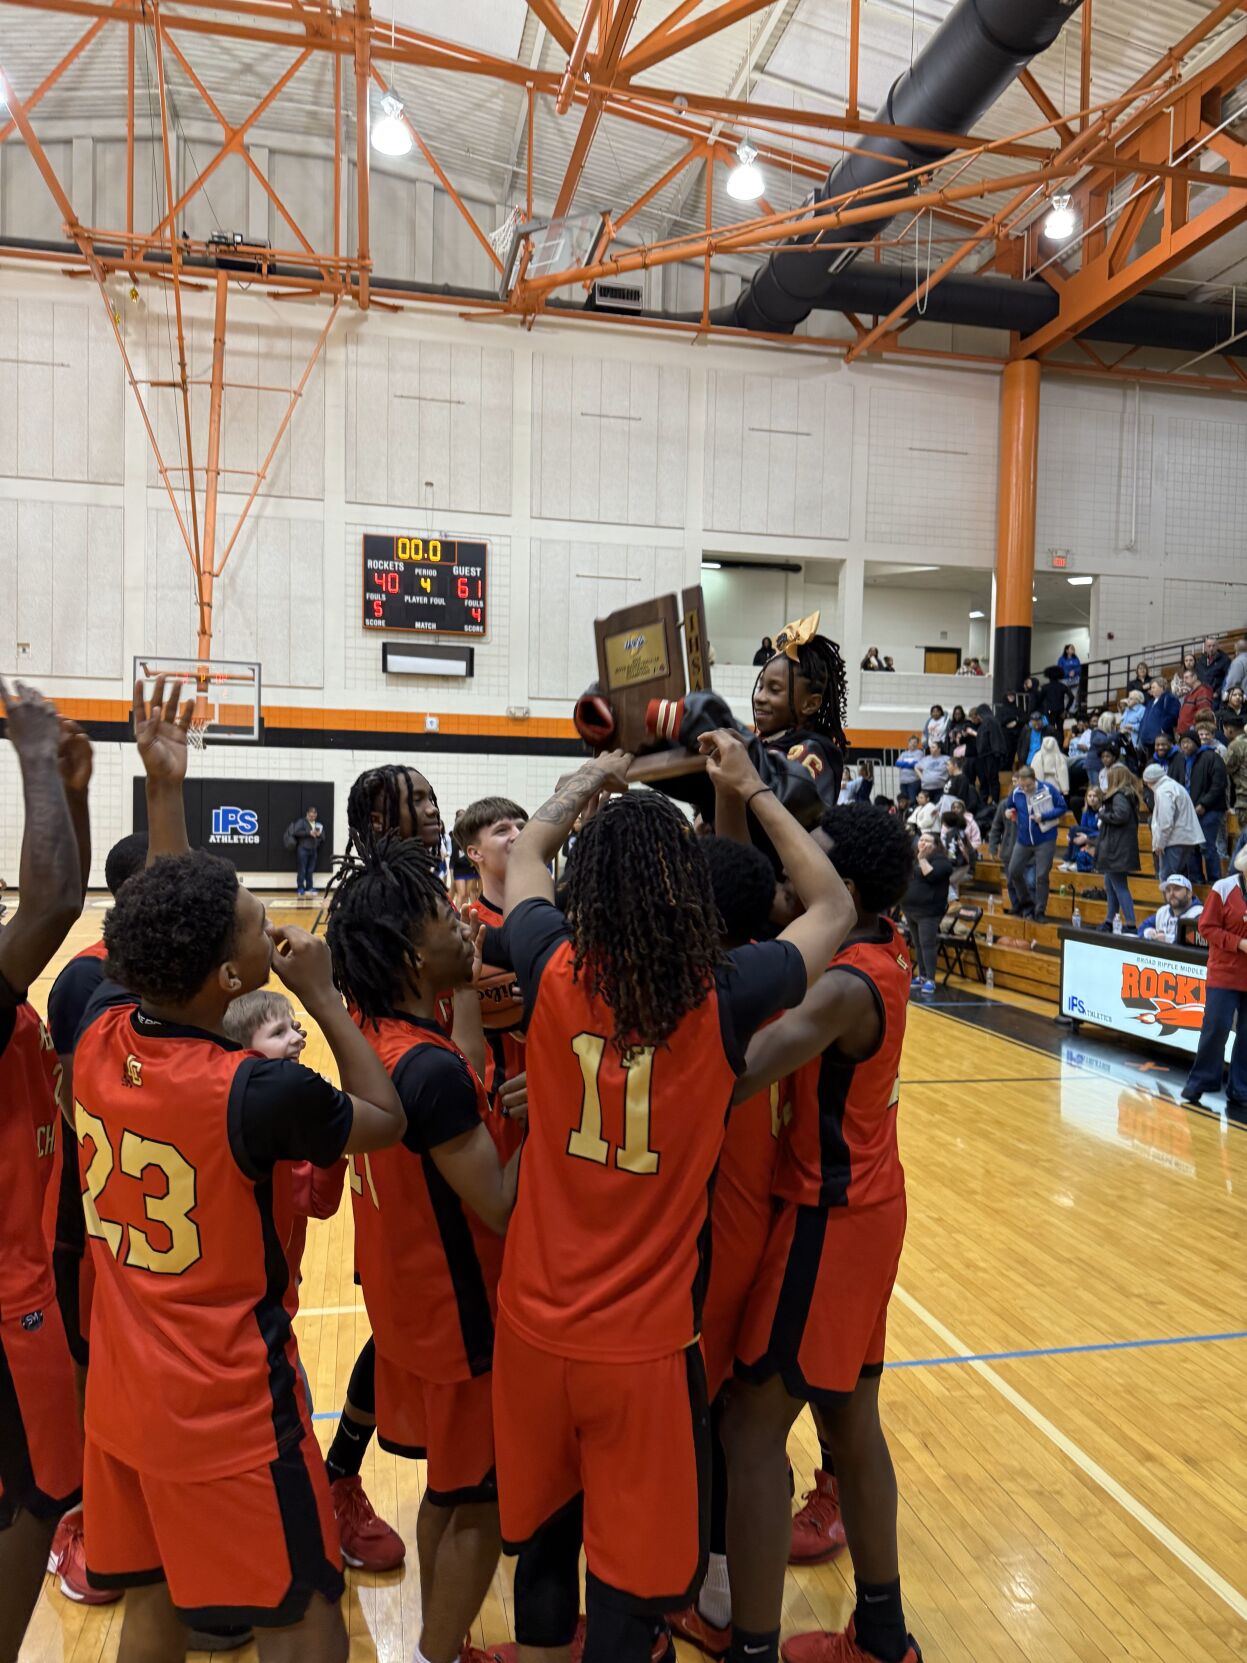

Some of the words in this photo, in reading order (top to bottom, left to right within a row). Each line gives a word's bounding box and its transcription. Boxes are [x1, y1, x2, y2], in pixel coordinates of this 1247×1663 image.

[397, 537, 441, 562] 00.0
[367, 558, 405, 572] ROCKETS
[414, 567, 438, 577] PERIOD
[452, 565, 482, 577] GUEST
[374, 572, 399, 594] 40
[420, 577, 431, 593] 4
[457, 577, 482, 599] 61
[366, 592, 387, 601] FOULS
[404, 595, 428, 604] PLAYER
[430, 596, 446, 606] FOUL
[464, 599, 484, 608] FOULS
[373, 600, 383, 618] 5
[471, 607, 481, 623] 4
[365, 618, 386, 627] SCORE
[415, 621, 437, 631] MATCH
[464, 624, 484, 633] SCORE
[212, 805, 259, 835] IPS
[209, 834, 260, 844] ATHLETICS
[1136, 956, 1157, 967] BROAD
[1157, 961, 1178, 971] RIPPLE
[1180, 965, 1204, 976] MIDDLE
[1068, 995, 1086, 1014] IPS
[566, 1030, 661, 1175] 11
[74, 1096, 203, 1276] 23
